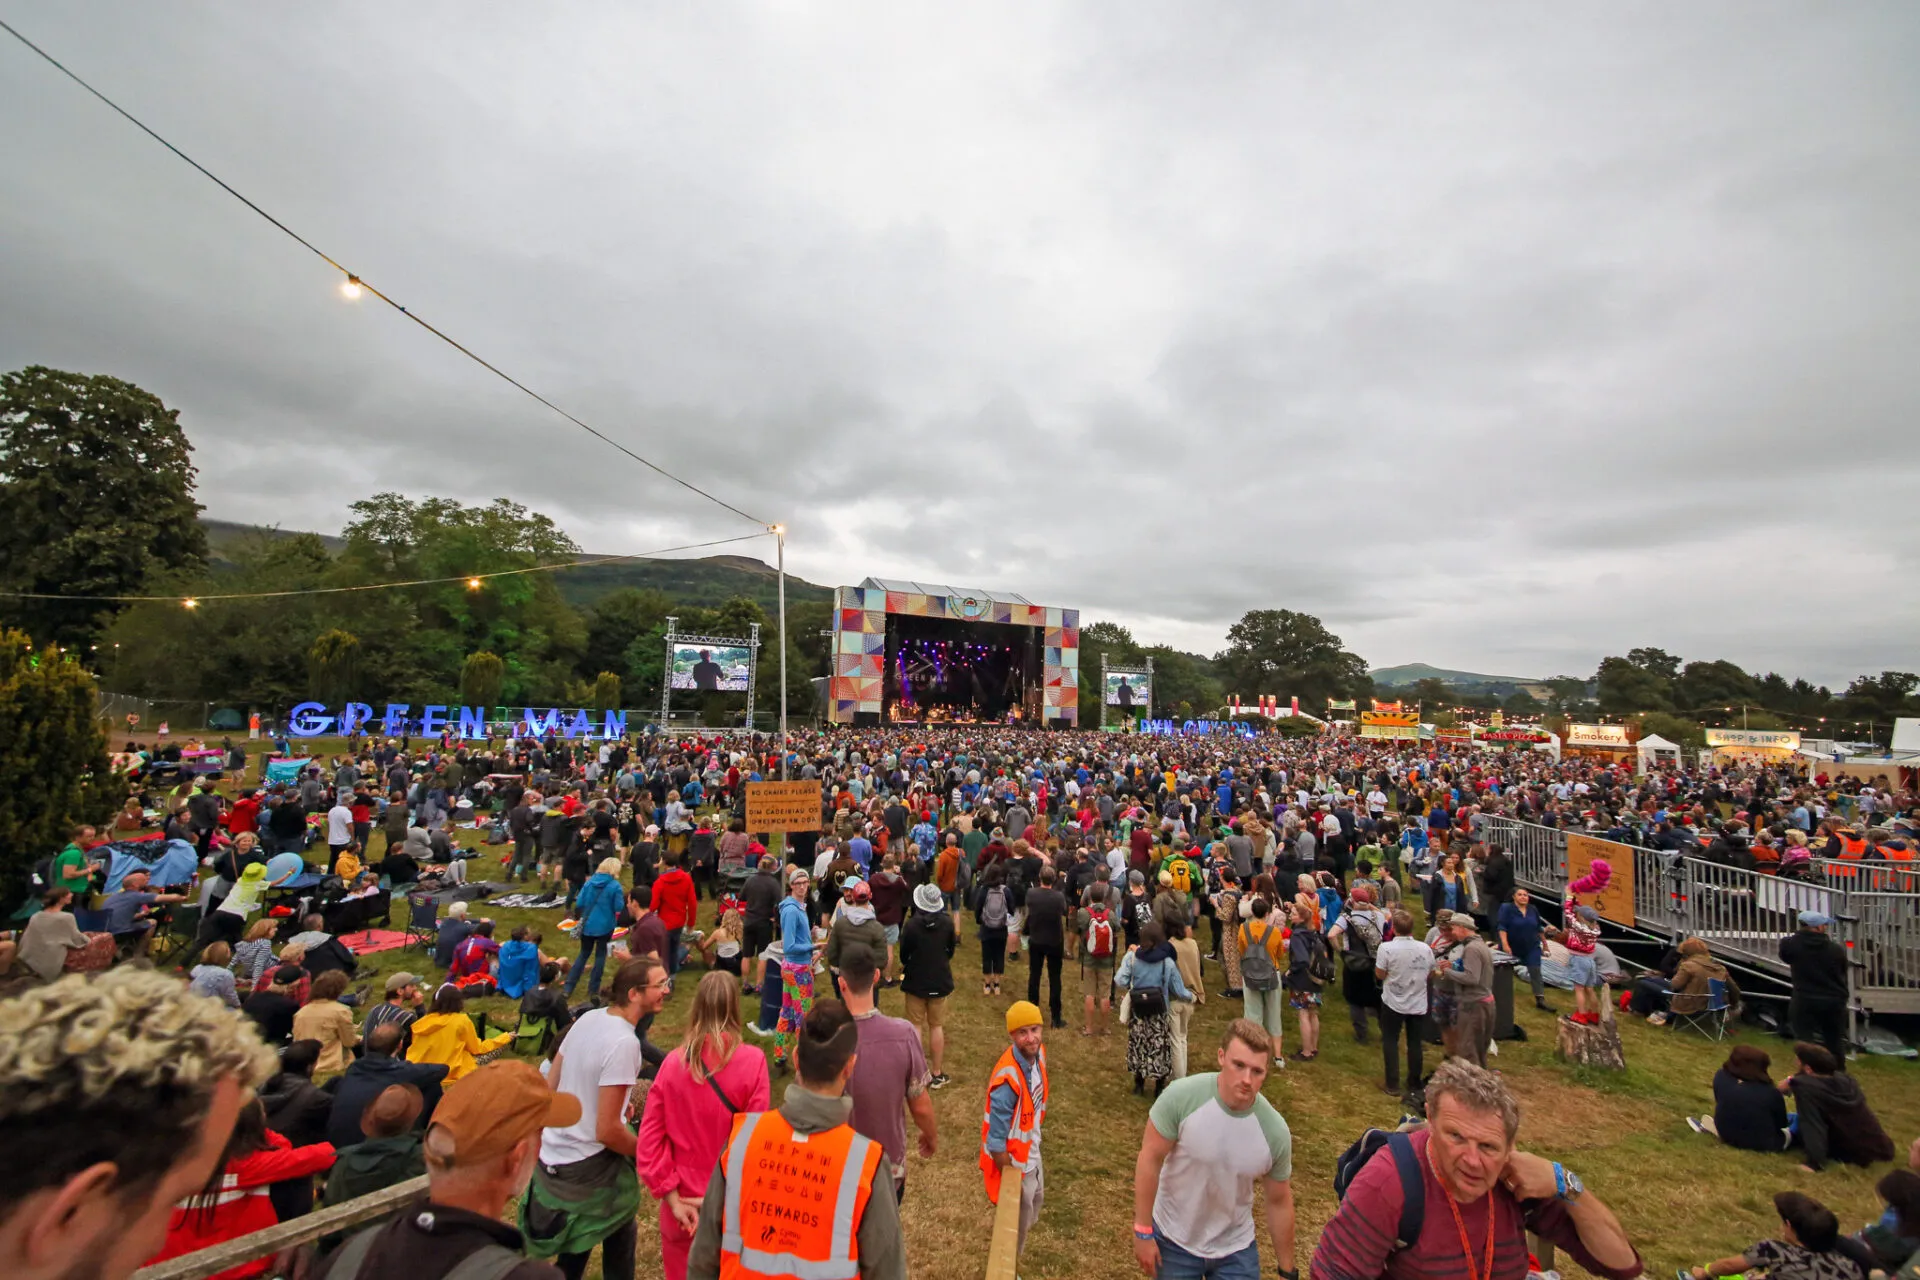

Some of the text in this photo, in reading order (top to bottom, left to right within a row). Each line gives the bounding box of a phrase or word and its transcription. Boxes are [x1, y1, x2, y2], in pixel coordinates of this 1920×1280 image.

[289, 701, 627, 740] GREEN MAN
[1574, 730, 1622, 743] Smokery
[1715, 733, 1791, 743] SHOP & INFO
[759, 1158, 827, 1184] GREEN MAN
[751, 1200, 819, 1228] STEWARDS
